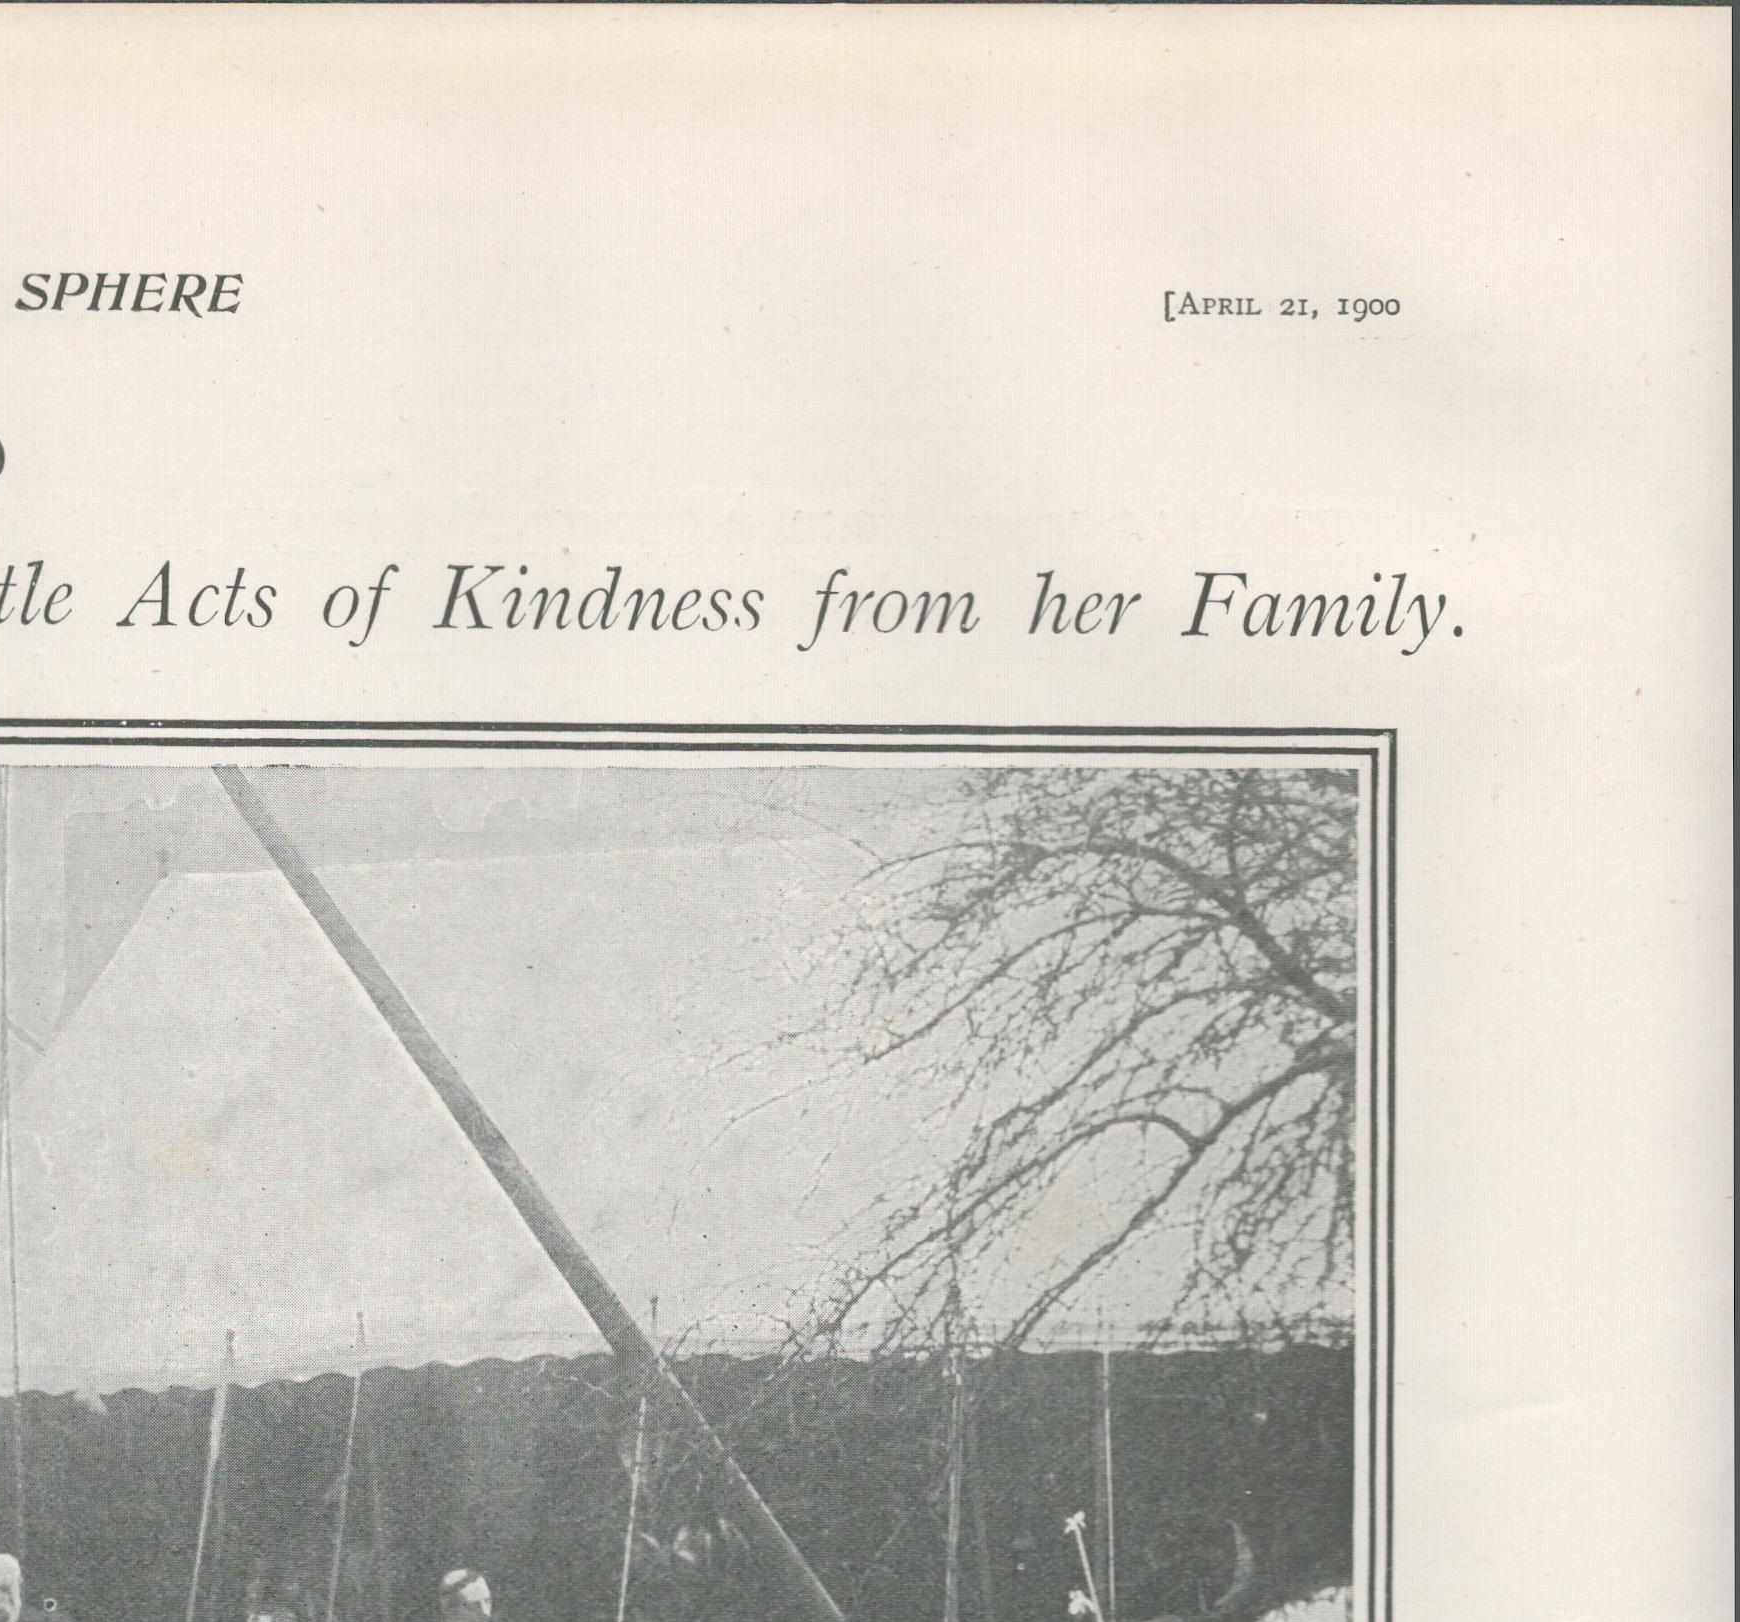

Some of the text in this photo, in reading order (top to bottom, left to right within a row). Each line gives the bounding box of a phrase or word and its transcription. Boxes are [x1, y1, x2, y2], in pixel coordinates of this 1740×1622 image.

[14, 272, 244, 319] SPHERE
[1280, 298, 1318, 320] 21,
[1338, 298, 1401, 323] 1900
[115, 560, 277, 628] Acts
[323, 564, 399, 648] of
[432, 564, 764, 631] Kindness
[796, 568, 981, 652] from
[1028, 570, 1142, 635] her
[1180, 572, 1463, 657] Family.
